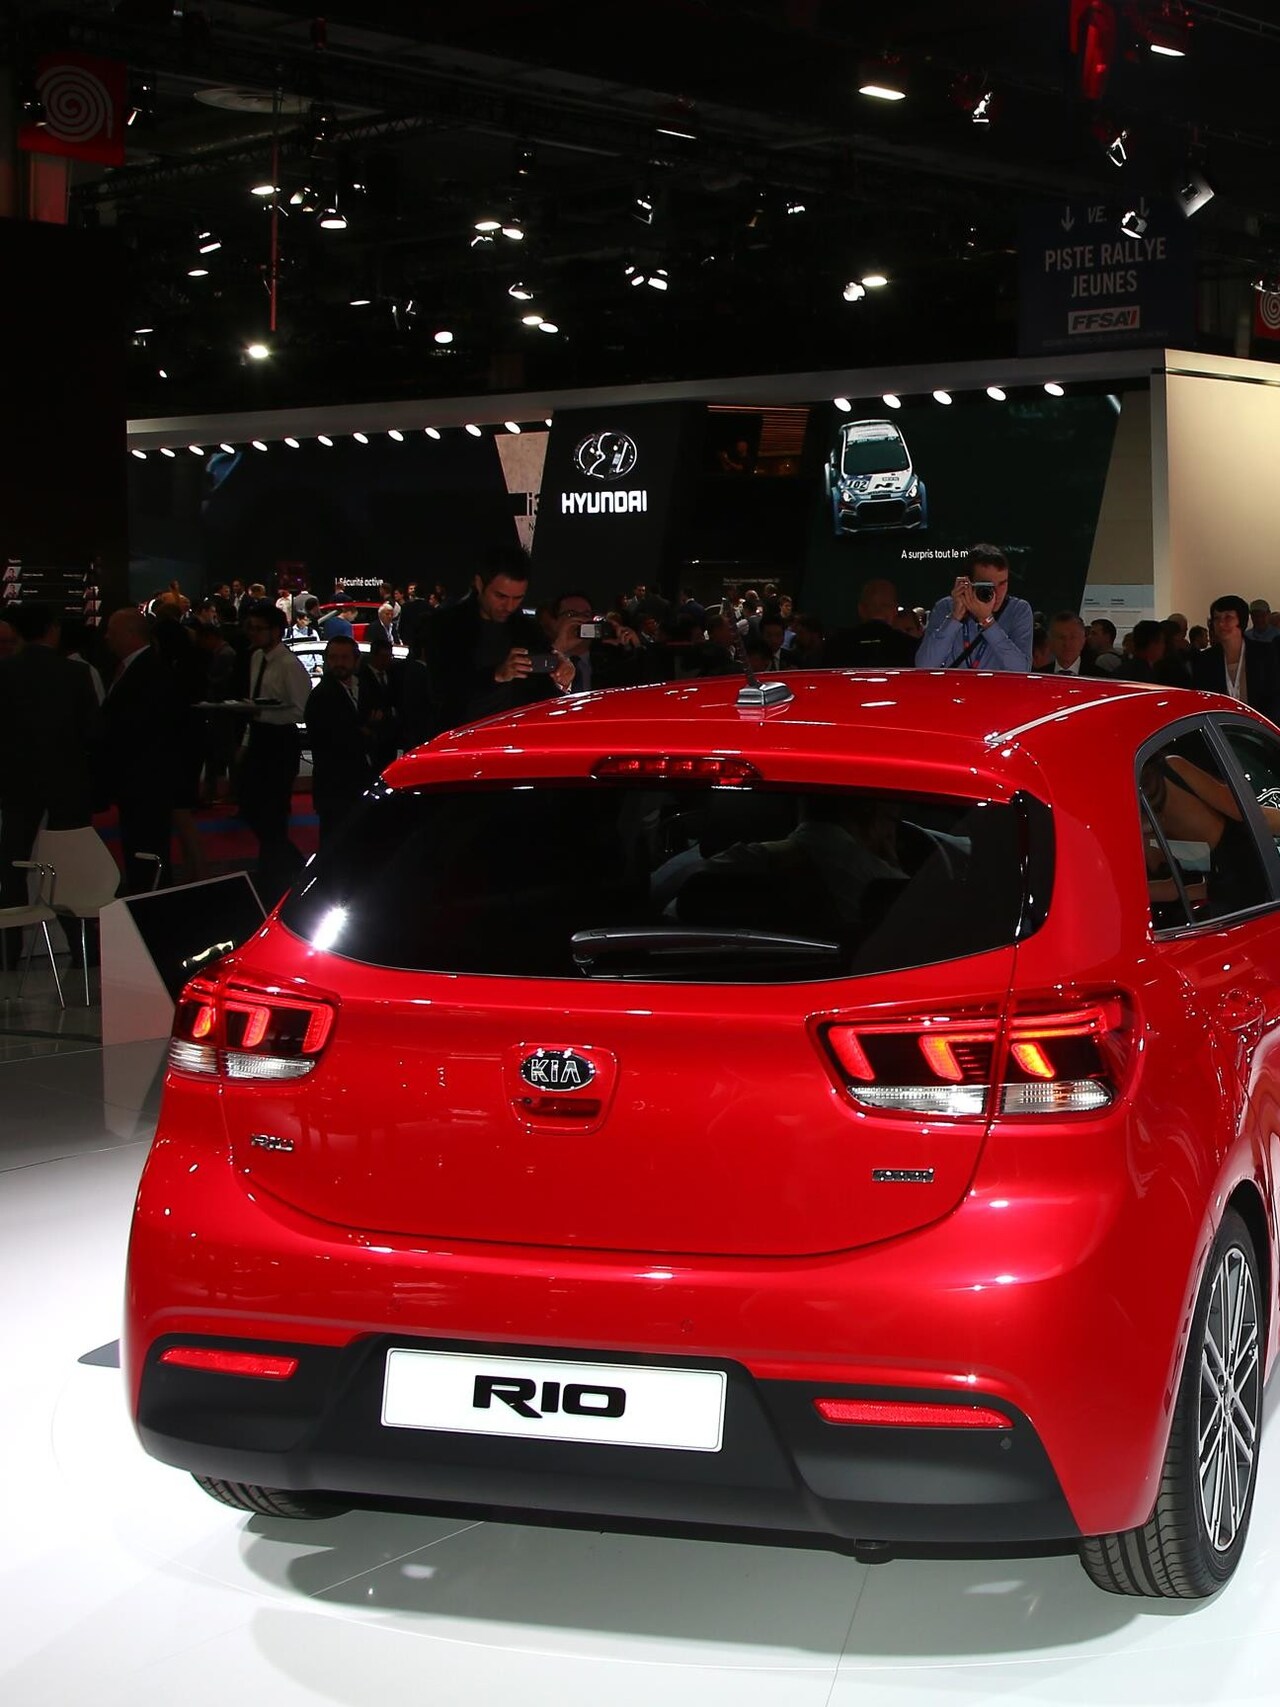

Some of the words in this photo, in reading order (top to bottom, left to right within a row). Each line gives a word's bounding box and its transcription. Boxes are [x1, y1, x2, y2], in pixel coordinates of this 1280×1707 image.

[1045, 245, 1094, 272] PISTE
[1101, 237, 1167, 265] RALLYE
[1071, 270, 1137, 298] JEUNES
[1072, 312, 1128, 331] FFSA
[561, 490, 648, 514] HYUNDAI
[900, 549, 908, 558] A
[908, 549, 934, 560] surpris
[935, 550, 951, 558] tout
[952, 549, 959, 558] le
[364, 577, 384, 586] active
[531, 1059, 581, 1083] KIA
[472, 1374, 627, 1419] RIO
